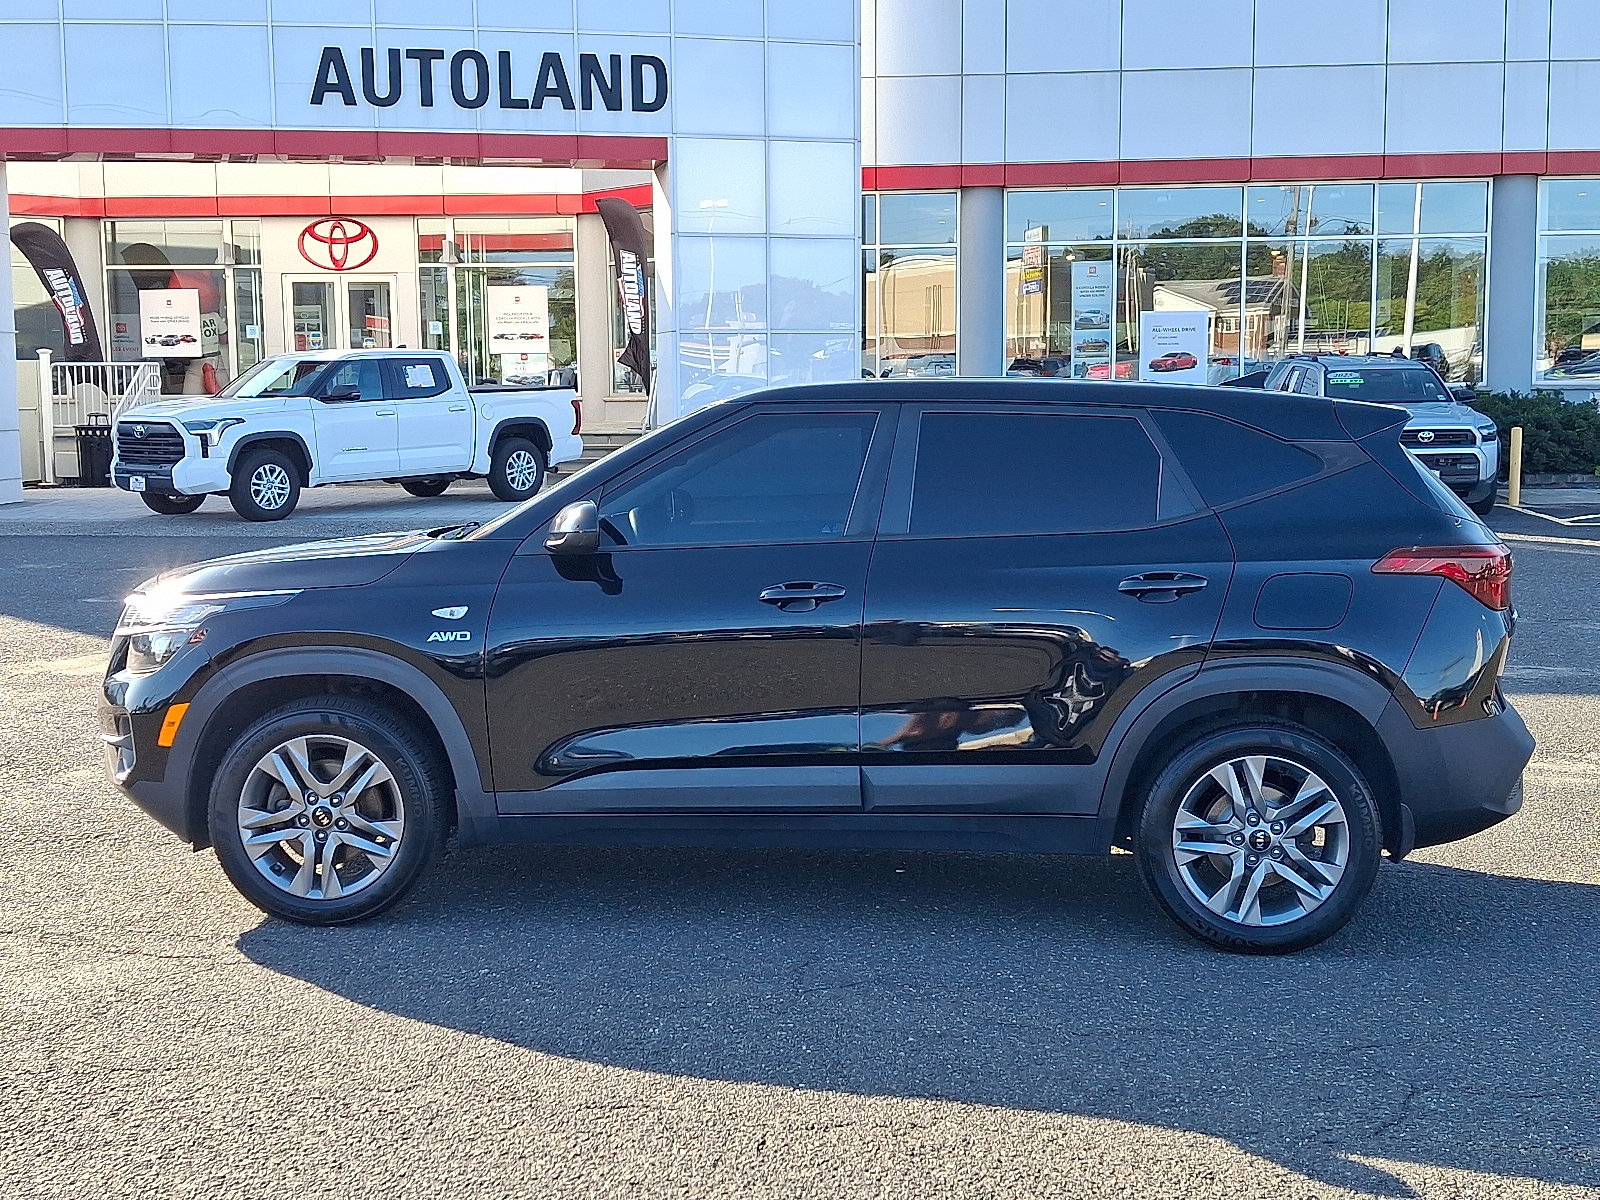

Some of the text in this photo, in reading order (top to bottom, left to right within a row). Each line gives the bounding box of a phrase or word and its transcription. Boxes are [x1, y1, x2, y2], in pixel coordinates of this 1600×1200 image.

[309, 46, 669, 113] AUTOLAND
[619, 249, 642, 335] AUTOLAND
[43, 267, 84, 345] AUTOLAND
[202, 318, 217, 329] AR
[203, 327, 218, 338] OX
[426, 631, 471, 642] AWD
[315, 807, 329, 825] KIA
[1255, 831, 1265, 849] KIA
